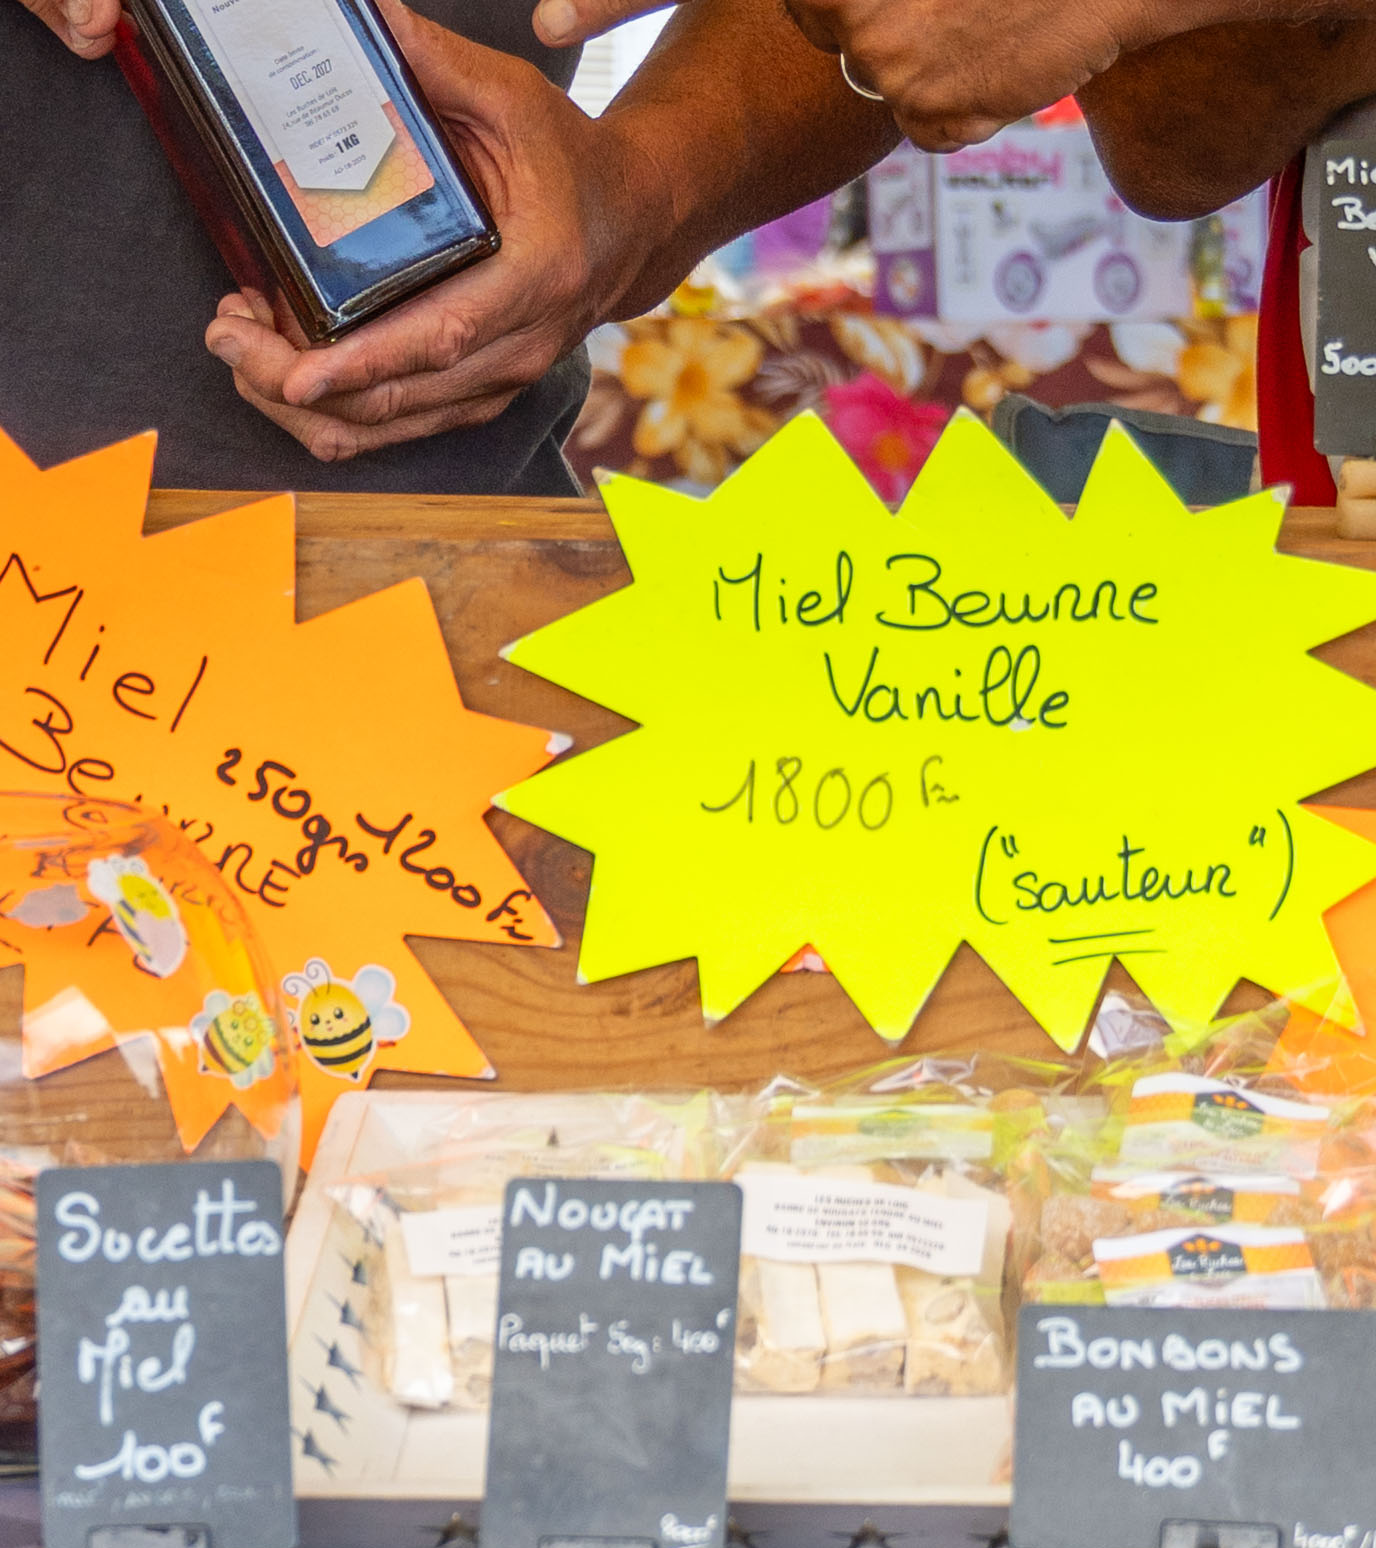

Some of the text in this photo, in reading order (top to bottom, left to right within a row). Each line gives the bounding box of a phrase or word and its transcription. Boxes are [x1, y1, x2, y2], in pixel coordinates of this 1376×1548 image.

[311, 58, 334, 79] 2027
[343, 133, 361, 151] KG
[712, 550, 1161, 634] Miel Beurre
[823, 643, 1072, 730] Vanille
[700, 756, 894, 832] 1800
[54, 1178, 283, 1265] Sucettes
[514, 1246, 575, 1282] AU
[106, 1284, 190, 1328] au
[77, 1325, 197, 1425] Miel
[1033, 1316, 1304, 1375] BONBONS
[1070, 1392, 1142, 1431] AU
